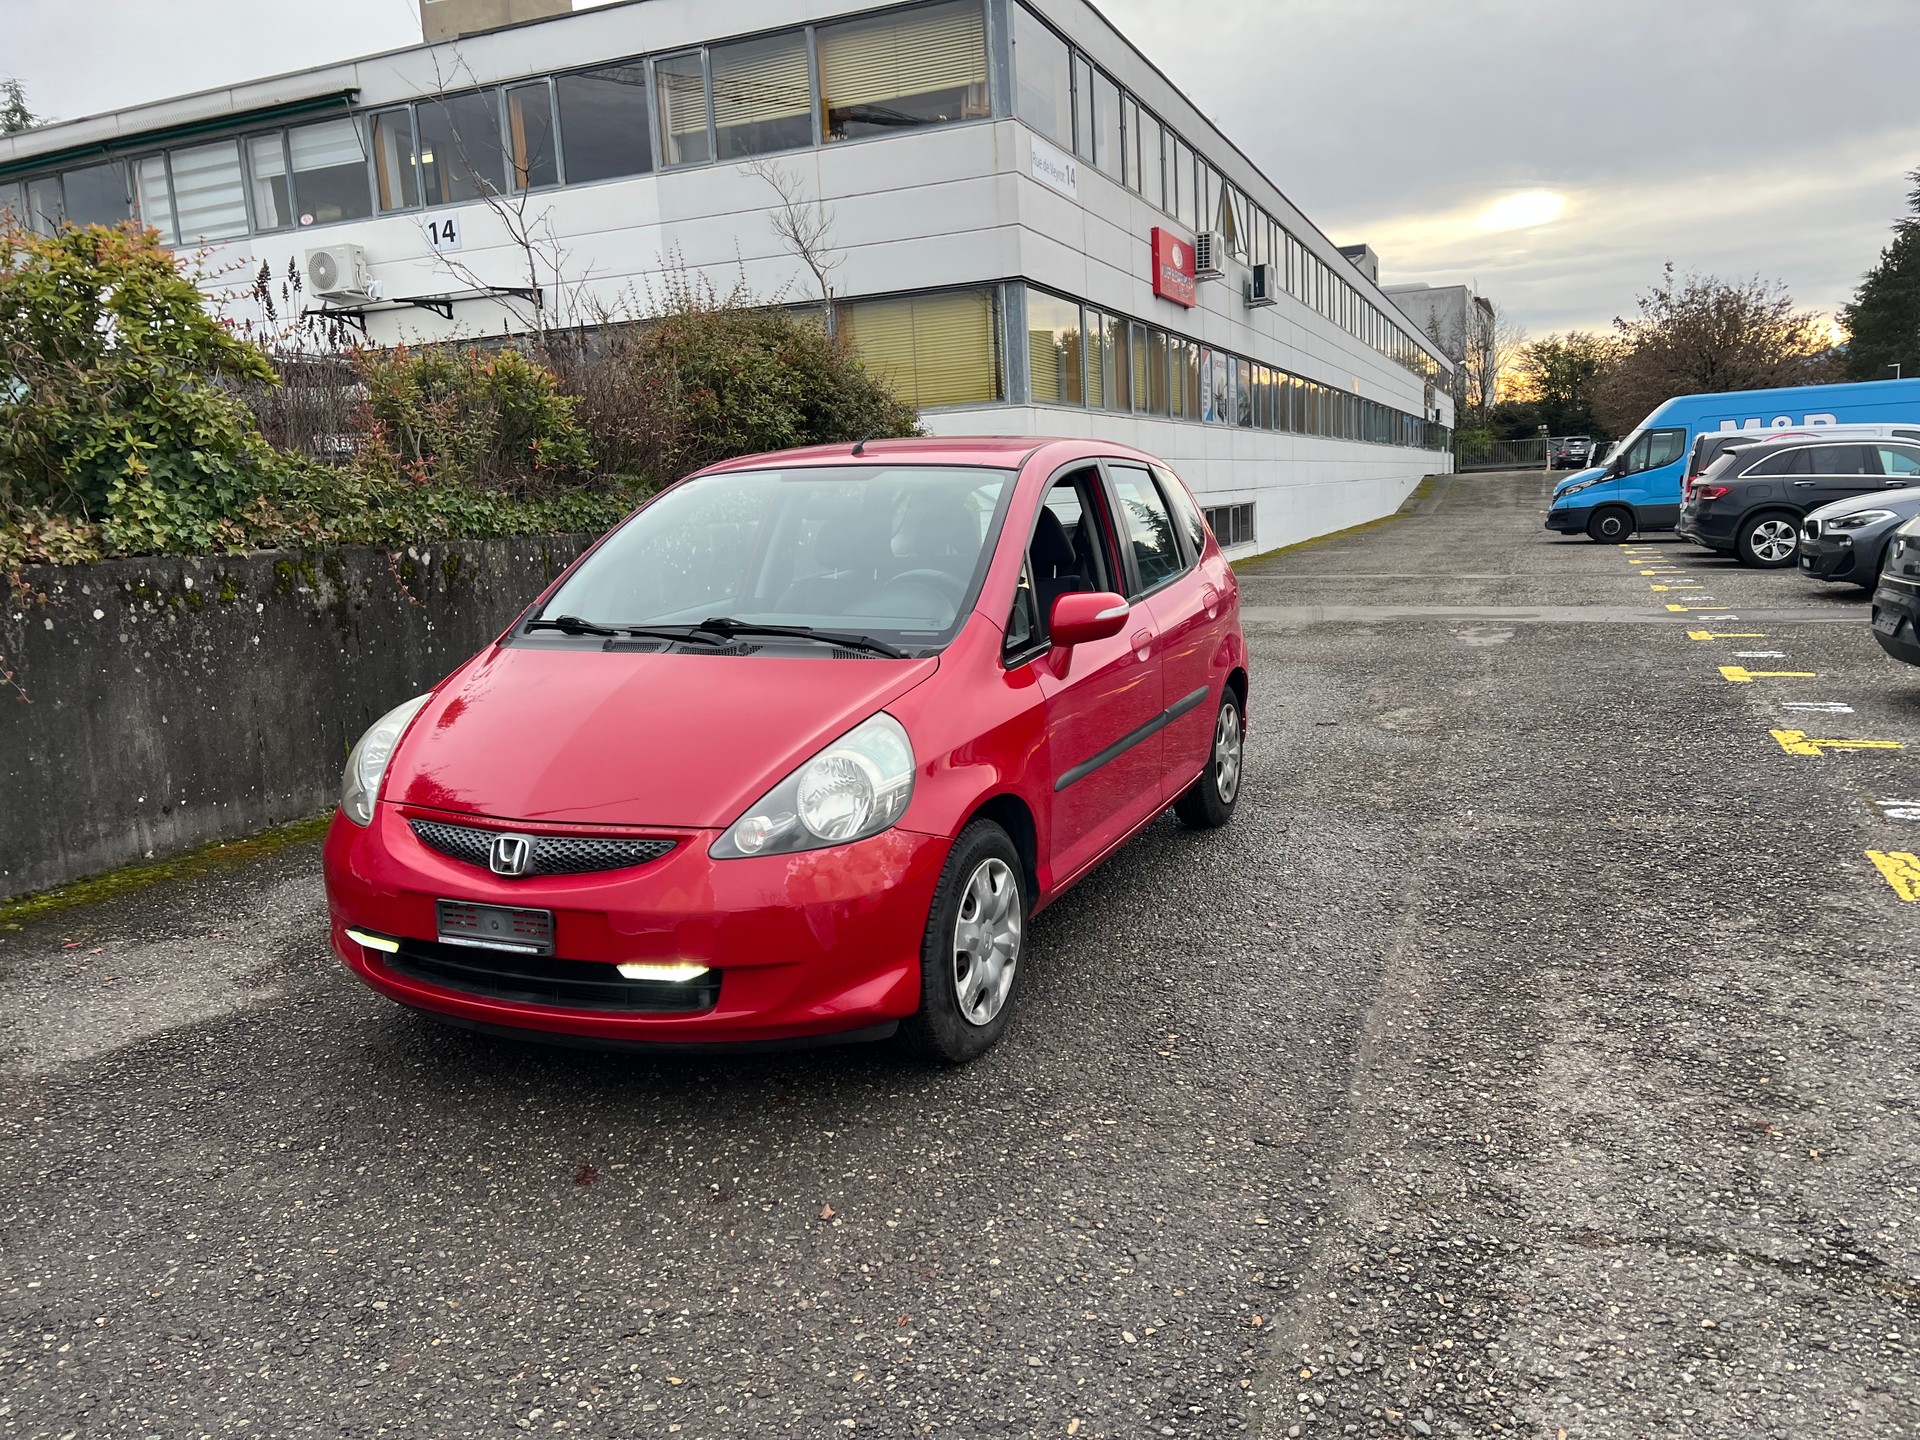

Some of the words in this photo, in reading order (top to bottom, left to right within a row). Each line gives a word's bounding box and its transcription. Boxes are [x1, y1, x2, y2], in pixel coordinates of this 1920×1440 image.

[1043, 158, 1050, 174] de
[1066, 164, 1076, 189] 14
[428, 219, 456, 245] 14
